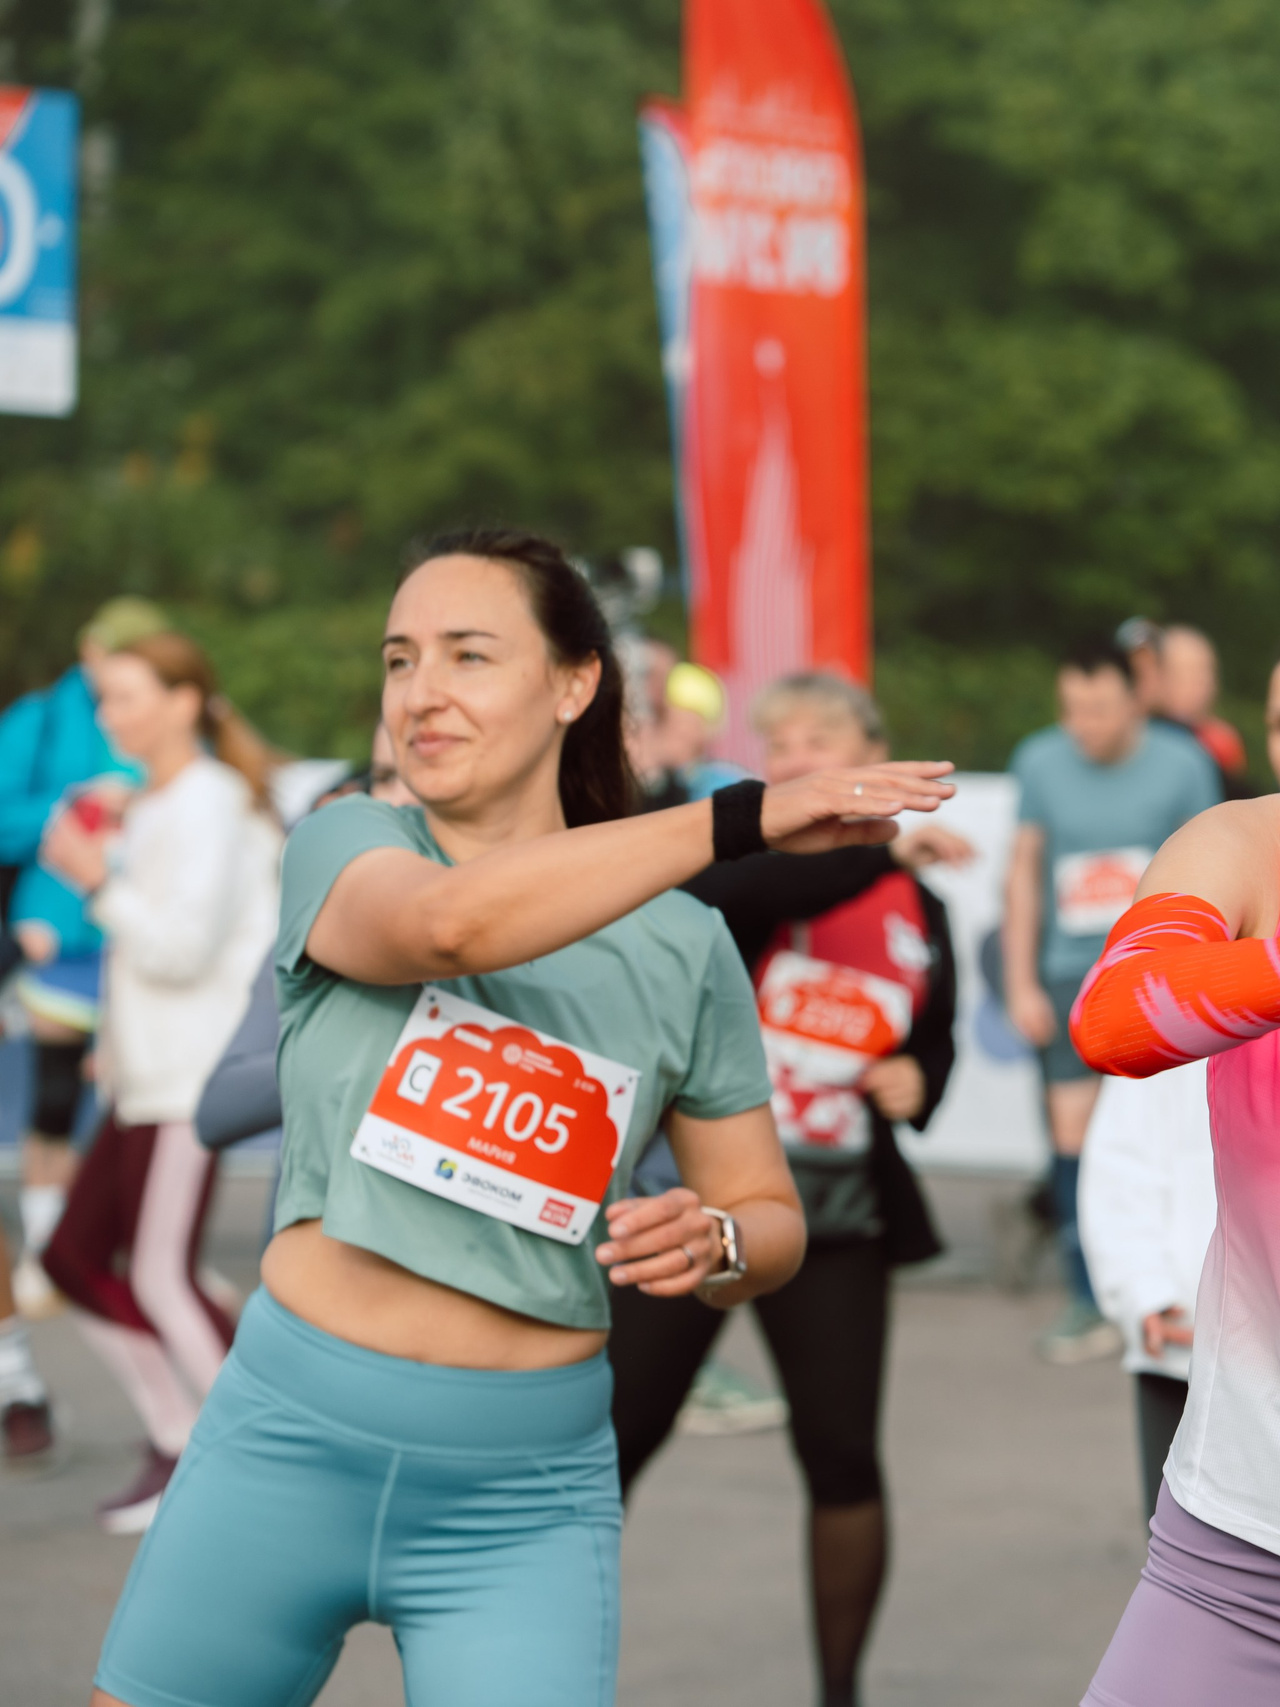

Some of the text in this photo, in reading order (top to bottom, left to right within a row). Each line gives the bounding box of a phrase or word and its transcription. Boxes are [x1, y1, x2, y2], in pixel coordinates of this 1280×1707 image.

[441, 1066, 577, 1154] 2105
[466, 1136, 517, 1165] МАРИЯ
[461, 1173, 522, 1202] ЭВОКОМ
